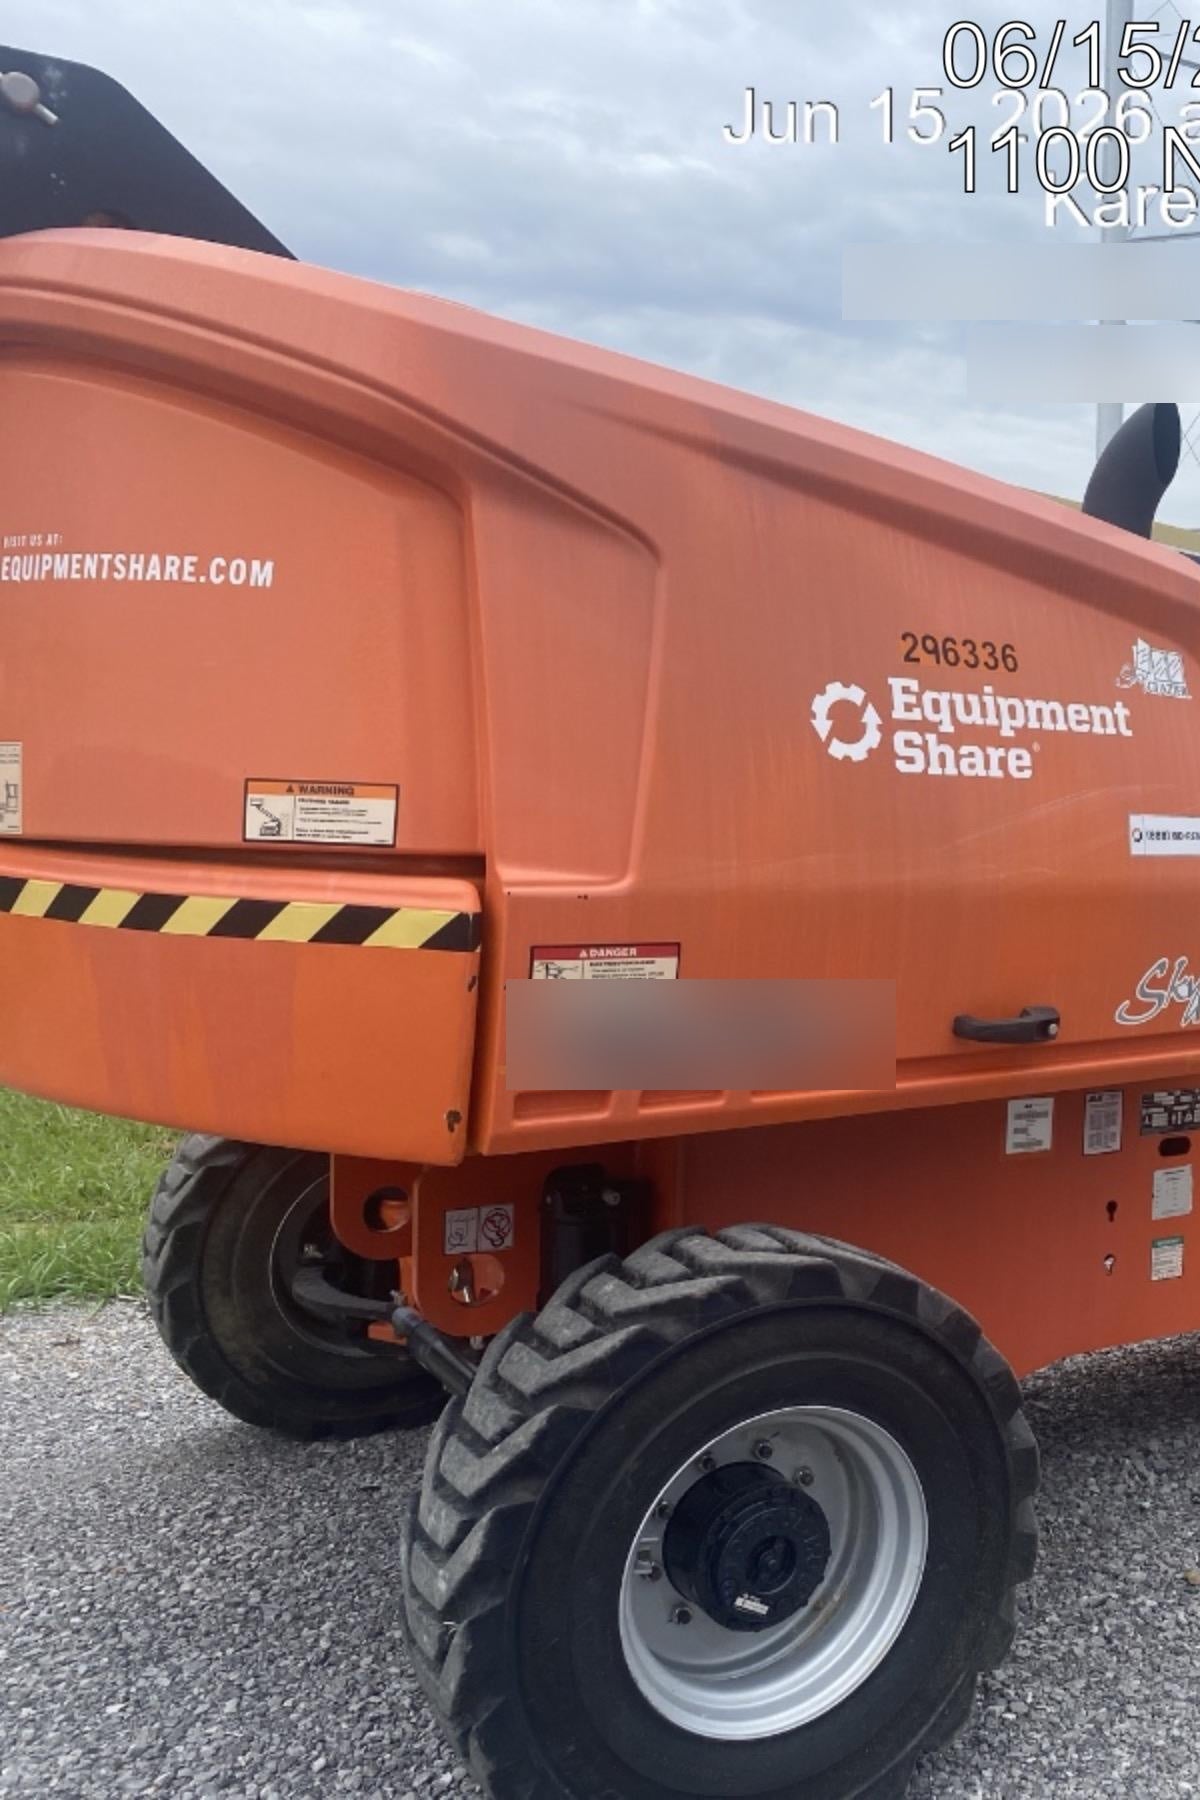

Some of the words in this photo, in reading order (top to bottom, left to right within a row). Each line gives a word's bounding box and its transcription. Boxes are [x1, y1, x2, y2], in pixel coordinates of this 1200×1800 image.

[1, 553, 274, 587] EQUIPMENTSHARE.COM
[901, 632, 1018, 673] 296336
[888, 677, 1132, 736] Equipment
[894, 732, 1033, 779] Share
[589, 947, 638, 958] DANGER
